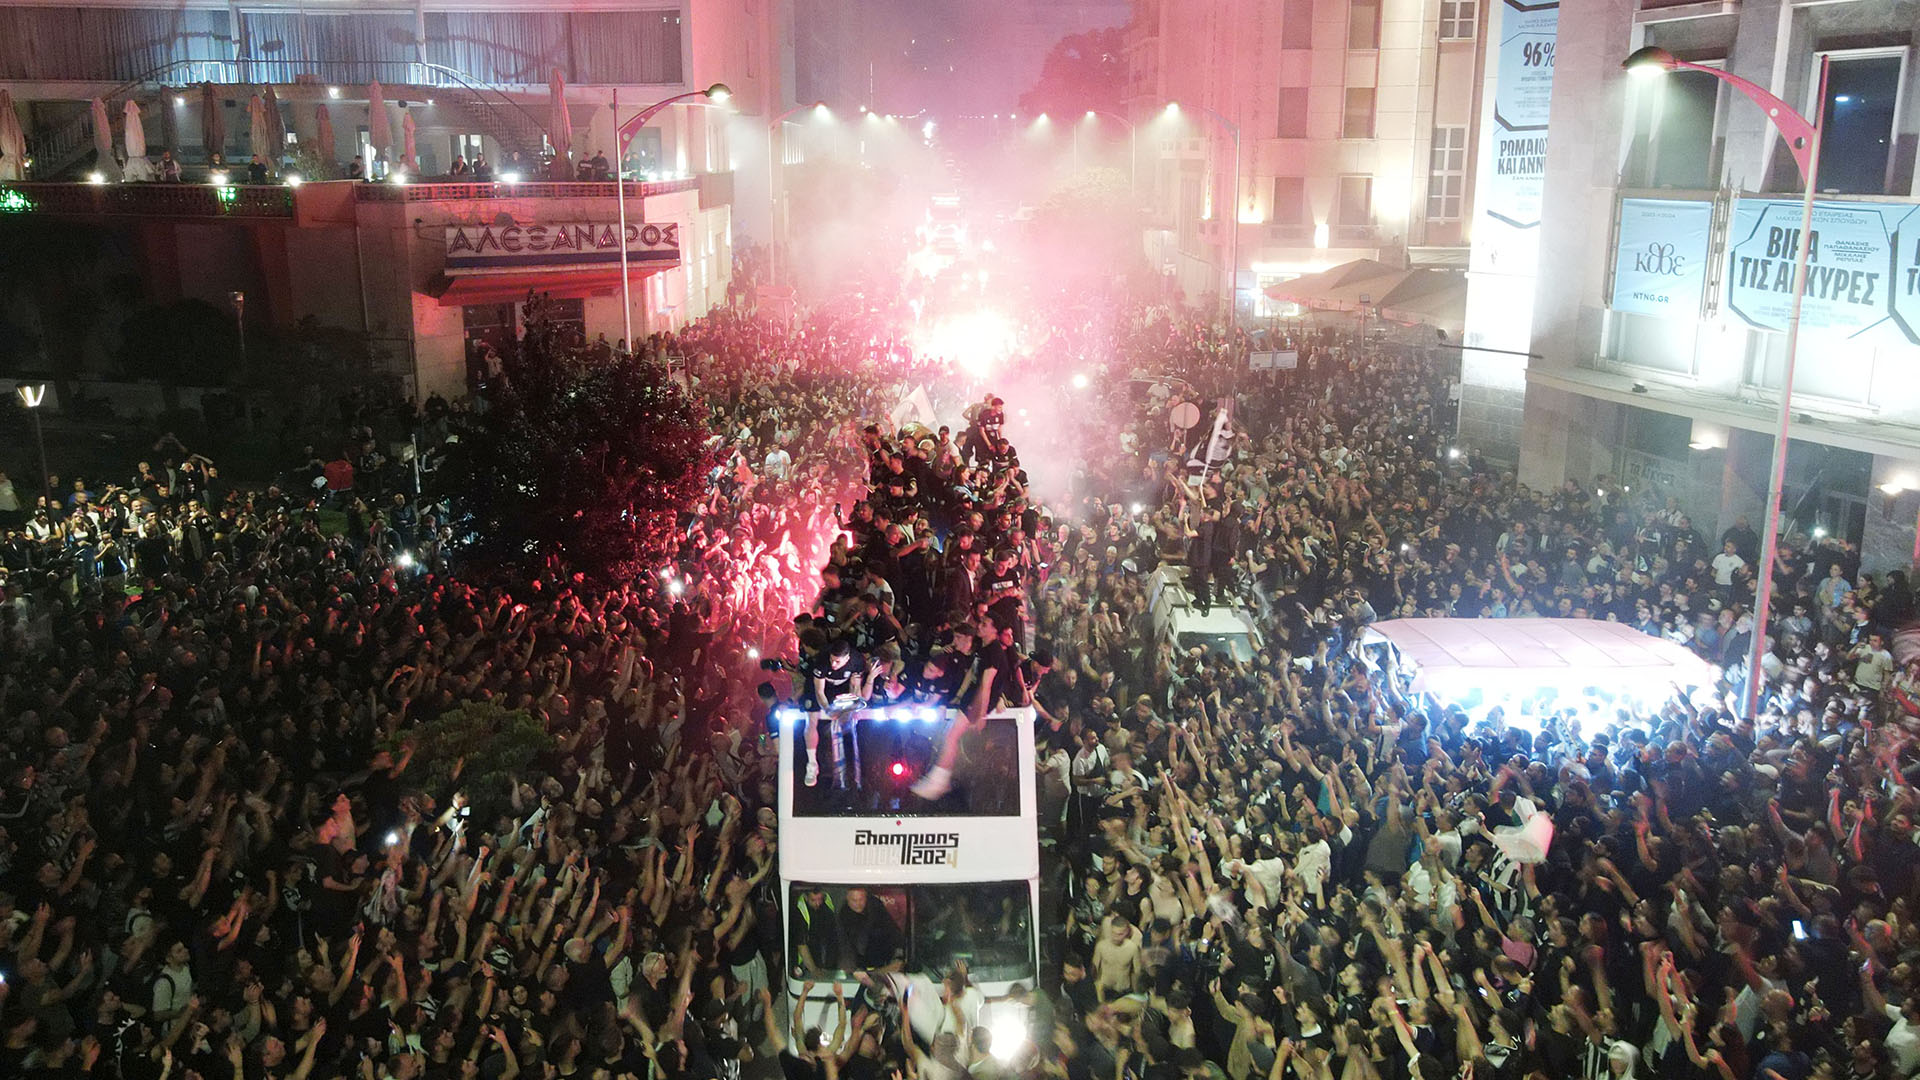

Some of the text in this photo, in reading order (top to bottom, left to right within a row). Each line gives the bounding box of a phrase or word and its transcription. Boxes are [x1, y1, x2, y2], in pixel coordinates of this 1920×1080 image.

[1523, 42, 1556, 67] 96%
[1498, 157, 1546, 175] ΚΑΙ ΑΝΝ
[449, 223, 679, 254] ΑΛΕΞΑΝΔΡΟΣ
[1739, 256, 1772, 290] ΤΙΣ
[1633, 292, 1669, 303] NTNG.GR
[912, 849, 958, 868] 2024
